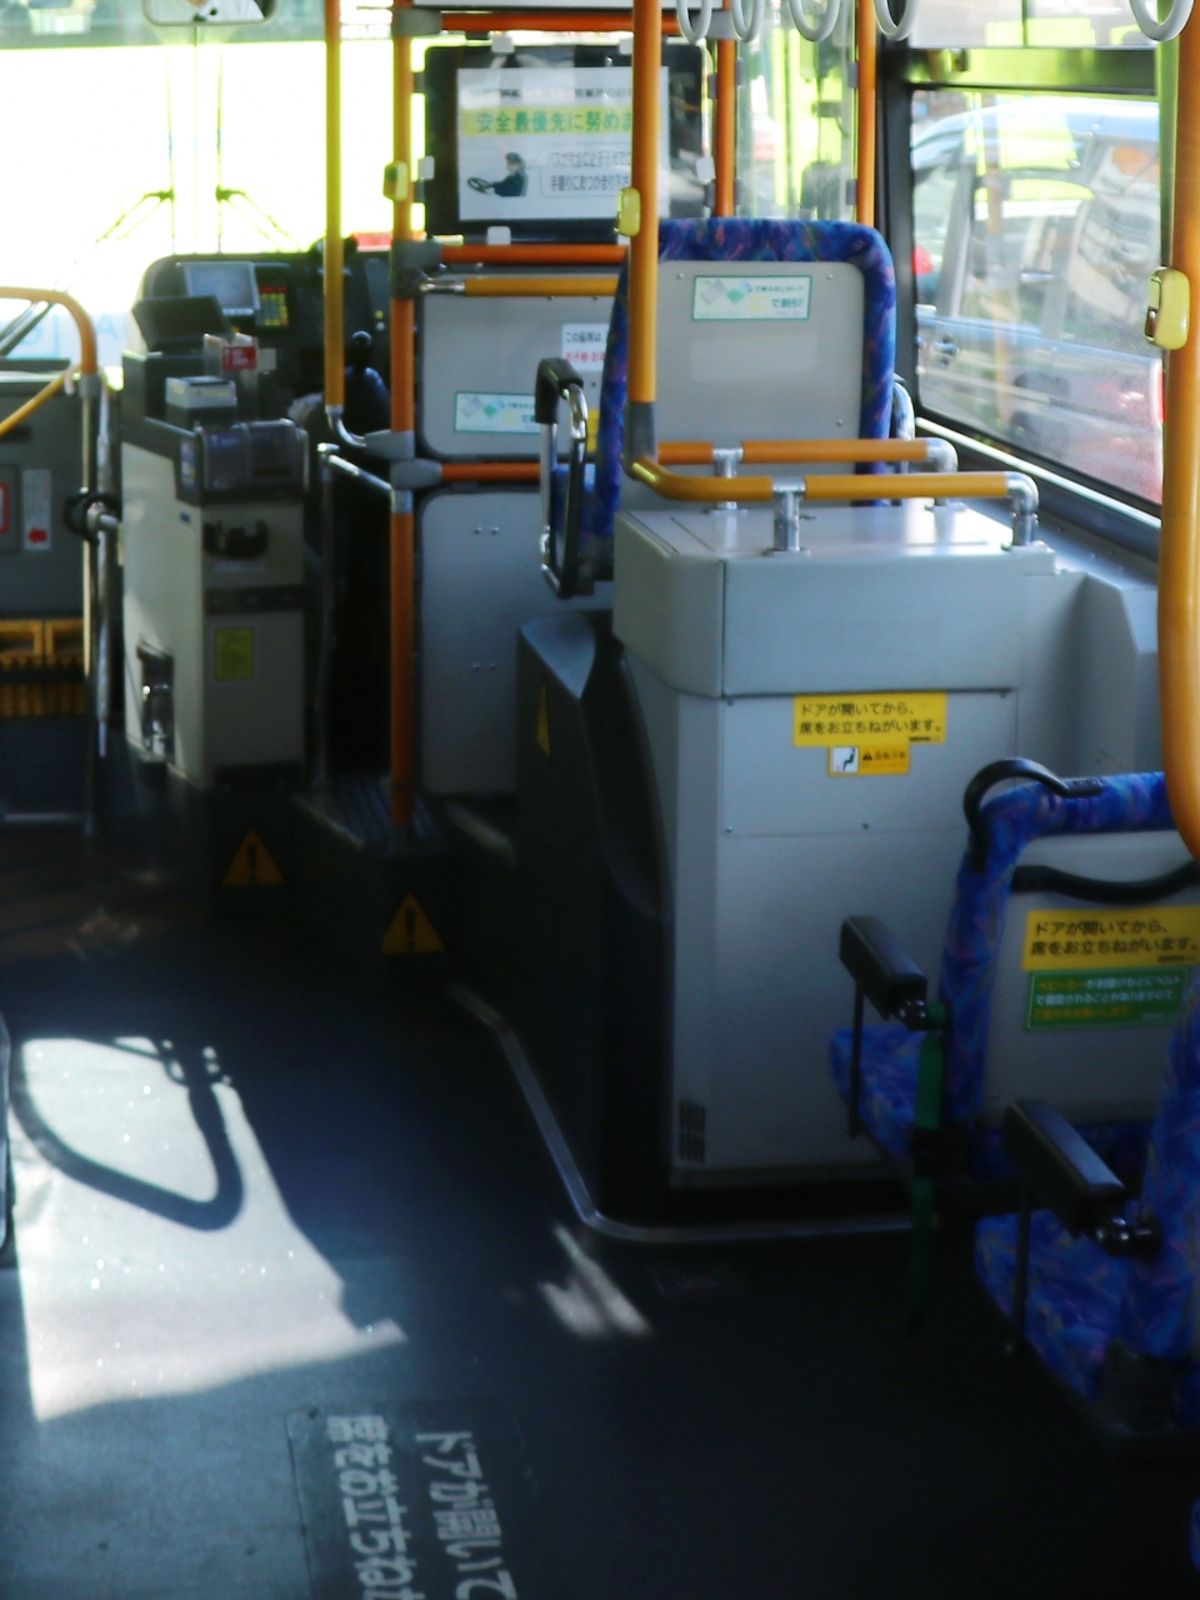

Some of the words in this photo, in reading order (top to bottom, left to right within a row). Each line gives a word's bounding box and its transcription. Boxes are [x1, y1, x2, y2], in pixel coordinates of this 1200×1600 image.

[802, 702, 914, 716] ドアが開いてから、
[800, 720, 941, 735] 席をお立ちねがいます。
[1035, 919, 1168, 936] ドアが開いてから、
[1030, 936, 1198, 957] 席をお立ちねがいます。
